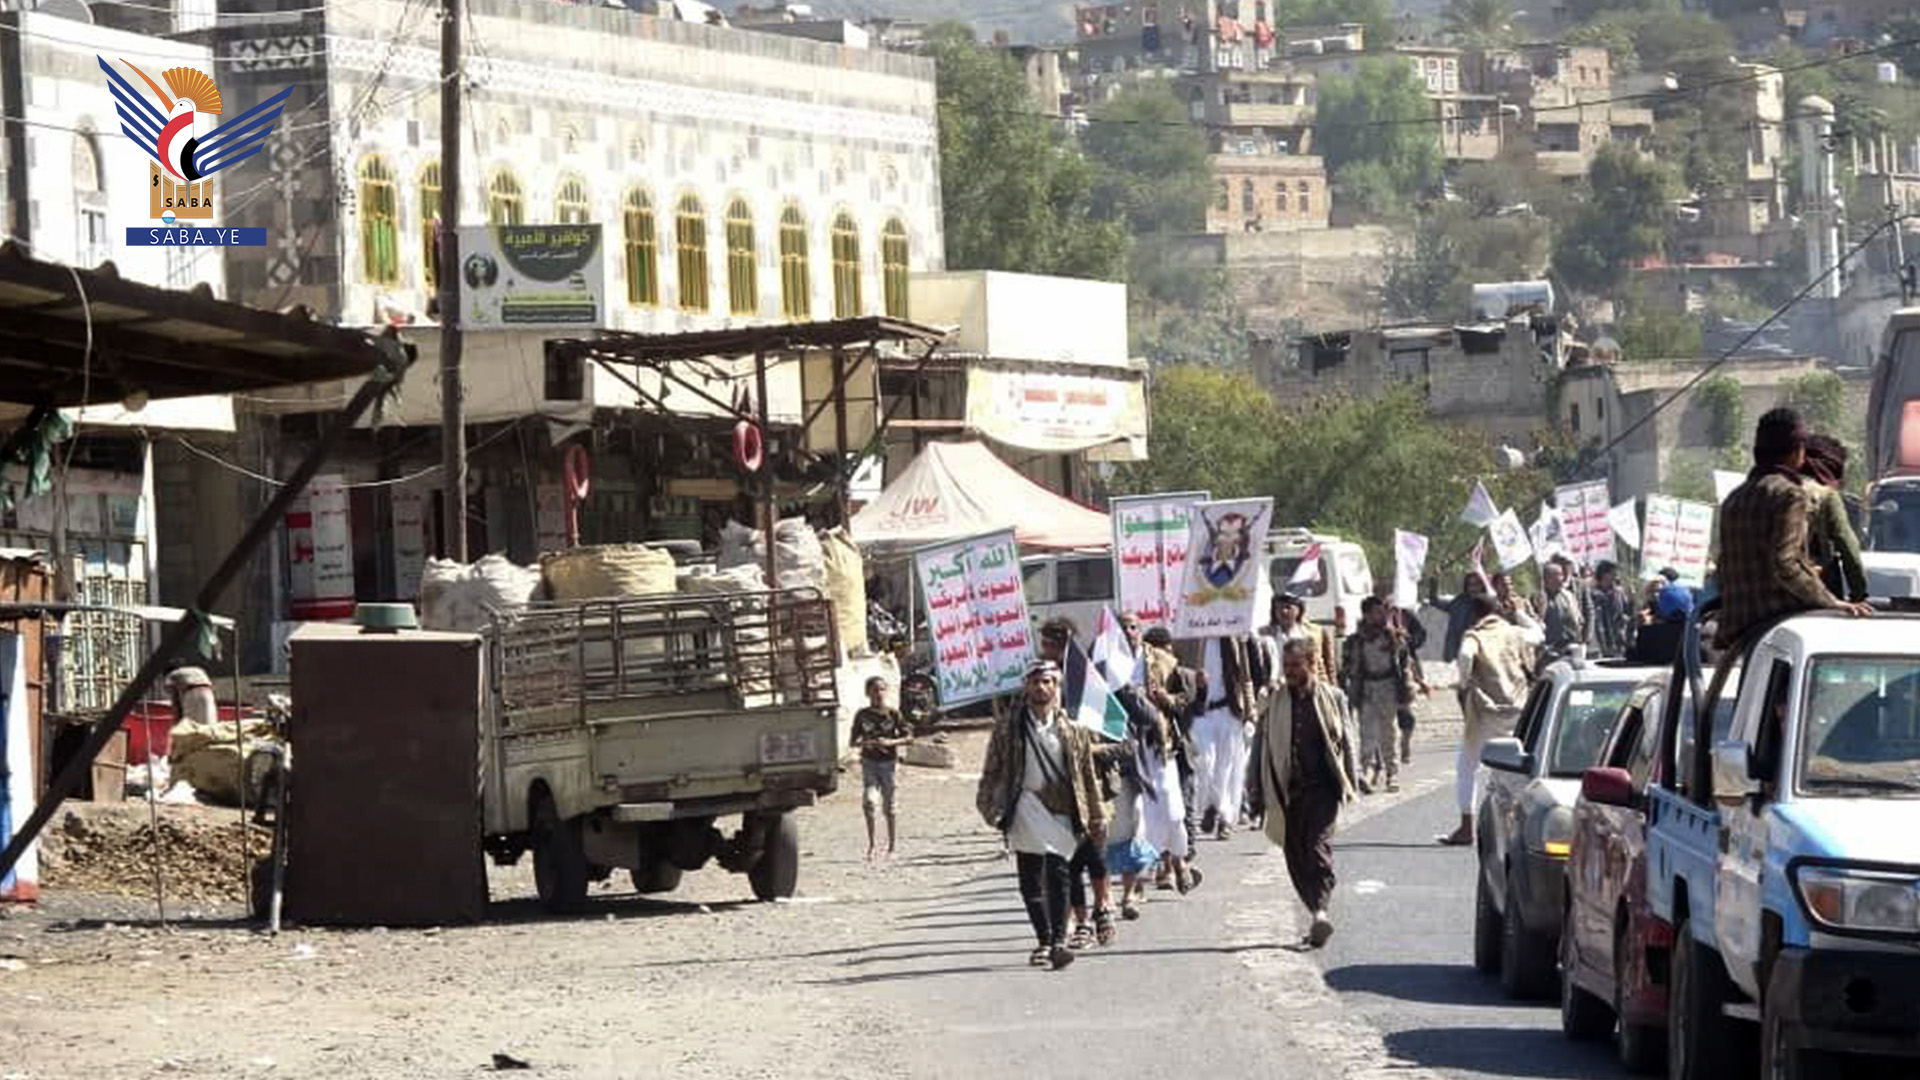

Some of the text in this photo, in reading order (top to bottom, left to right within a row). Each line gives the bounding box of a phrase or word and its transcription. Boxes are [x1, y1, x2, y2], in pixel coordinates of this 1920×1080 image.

[979, 542, 1016, 569] الله
[978, 576, 1020, 600] الموت
[985, 604, 1026, 627] الموت
